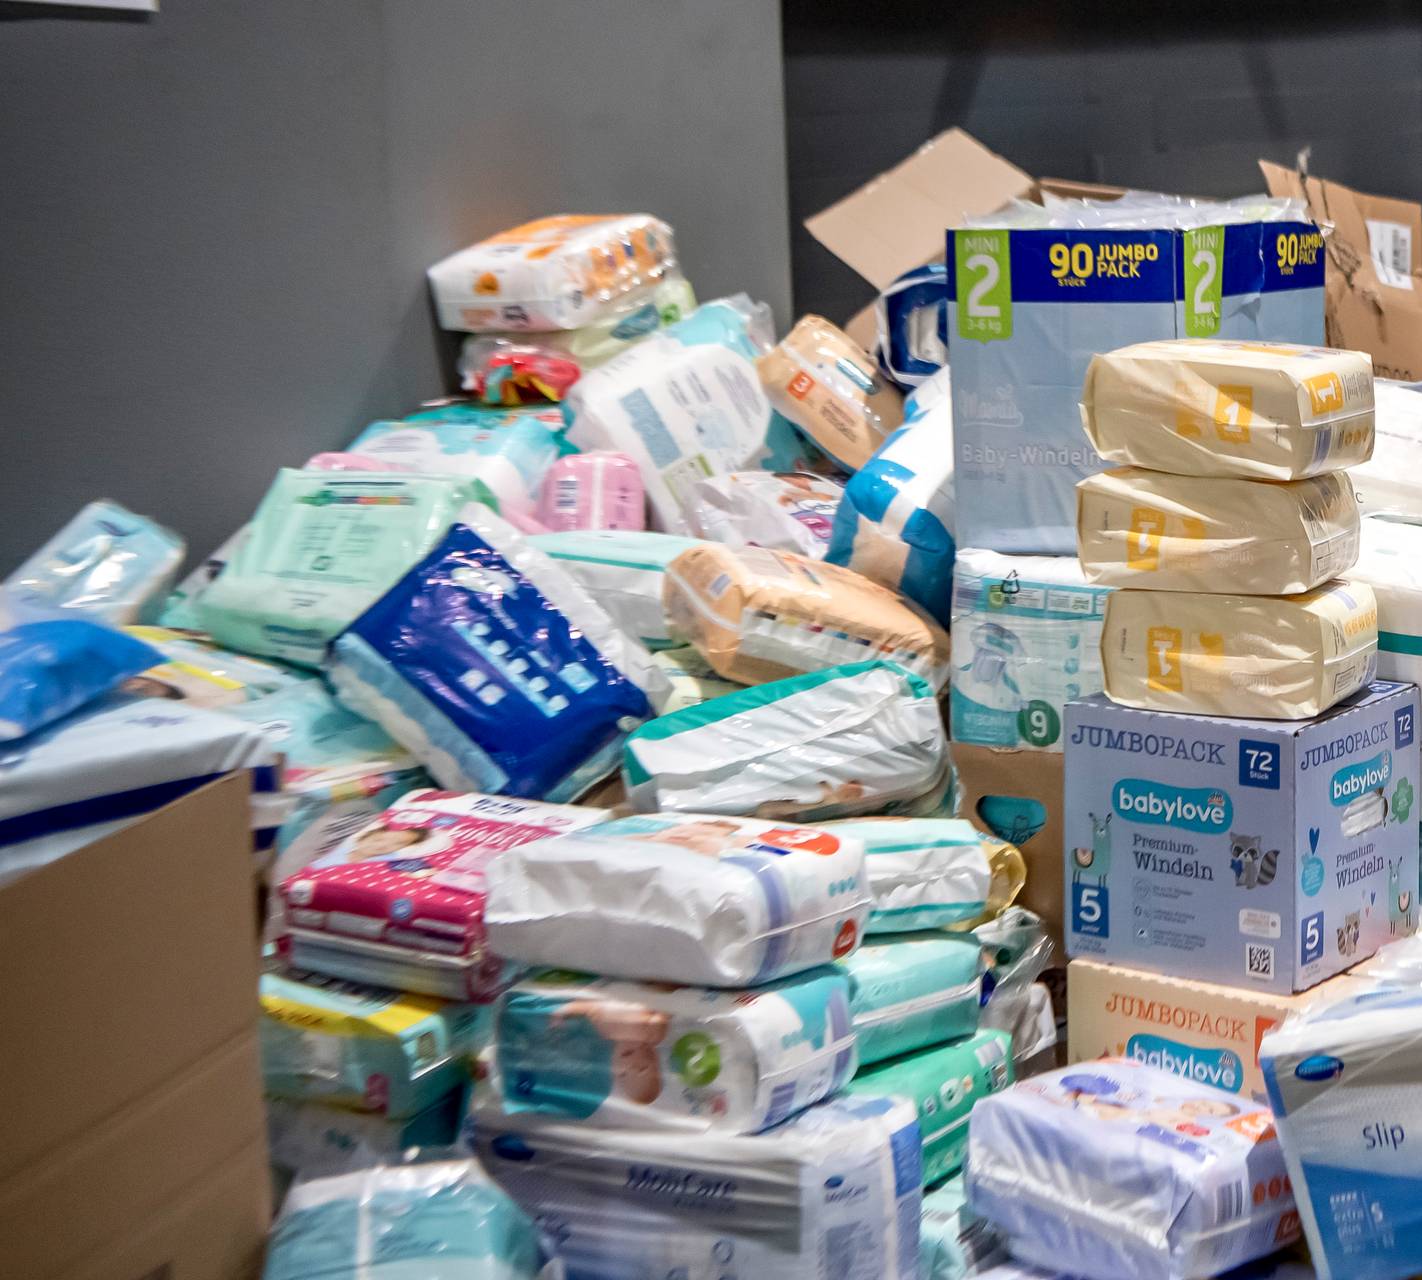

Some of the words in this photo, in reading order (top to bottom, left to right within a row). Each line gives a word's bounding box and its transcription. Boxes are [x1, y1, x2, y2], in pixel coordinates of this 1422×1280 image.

[965, 237, 999, 253] MINI
[1096, 243, 1159, 262] JUMBO
[1192, 233, 1219, 249] MINI
[1276, 233, 1299, 268] 90
[1299, 232, 1323, 251] JUMBO
[1299, 248, 1317, 265] PACK
[1049, 243, 1094, 278] 90
[1096, 260, 1141, 278] PACK
[965, 253, 1000, 317] 2
[1192, 250, 1217, 314] 2
[1223, 401, 1243, 433] 1
[1397, 713, 1411, 733] 72
[1071, 724, 1226, 766] JUMBOPACK
[1245, 748, 1273, 772] 72
[1300, 721, 1389, 772] JUMBOPACK
[1333, 764, 1390, 799] babylove
[1119, 788, 1225, 825] babylove
[1132, 833, 1199, 855] Premium-
[1132, 851, 1214, 882] Windeln
[1336, 855, 1385, 891] Windeln
[1079, 888, 1101, 923] 5
[1305, 917, 1319, 951] 5
[1105, 992, 1249, 1042] JUMBOPACK
[1132, 1040, 1236, 1088] babylove
[1362, 1120, 1405, 1150] Slip
